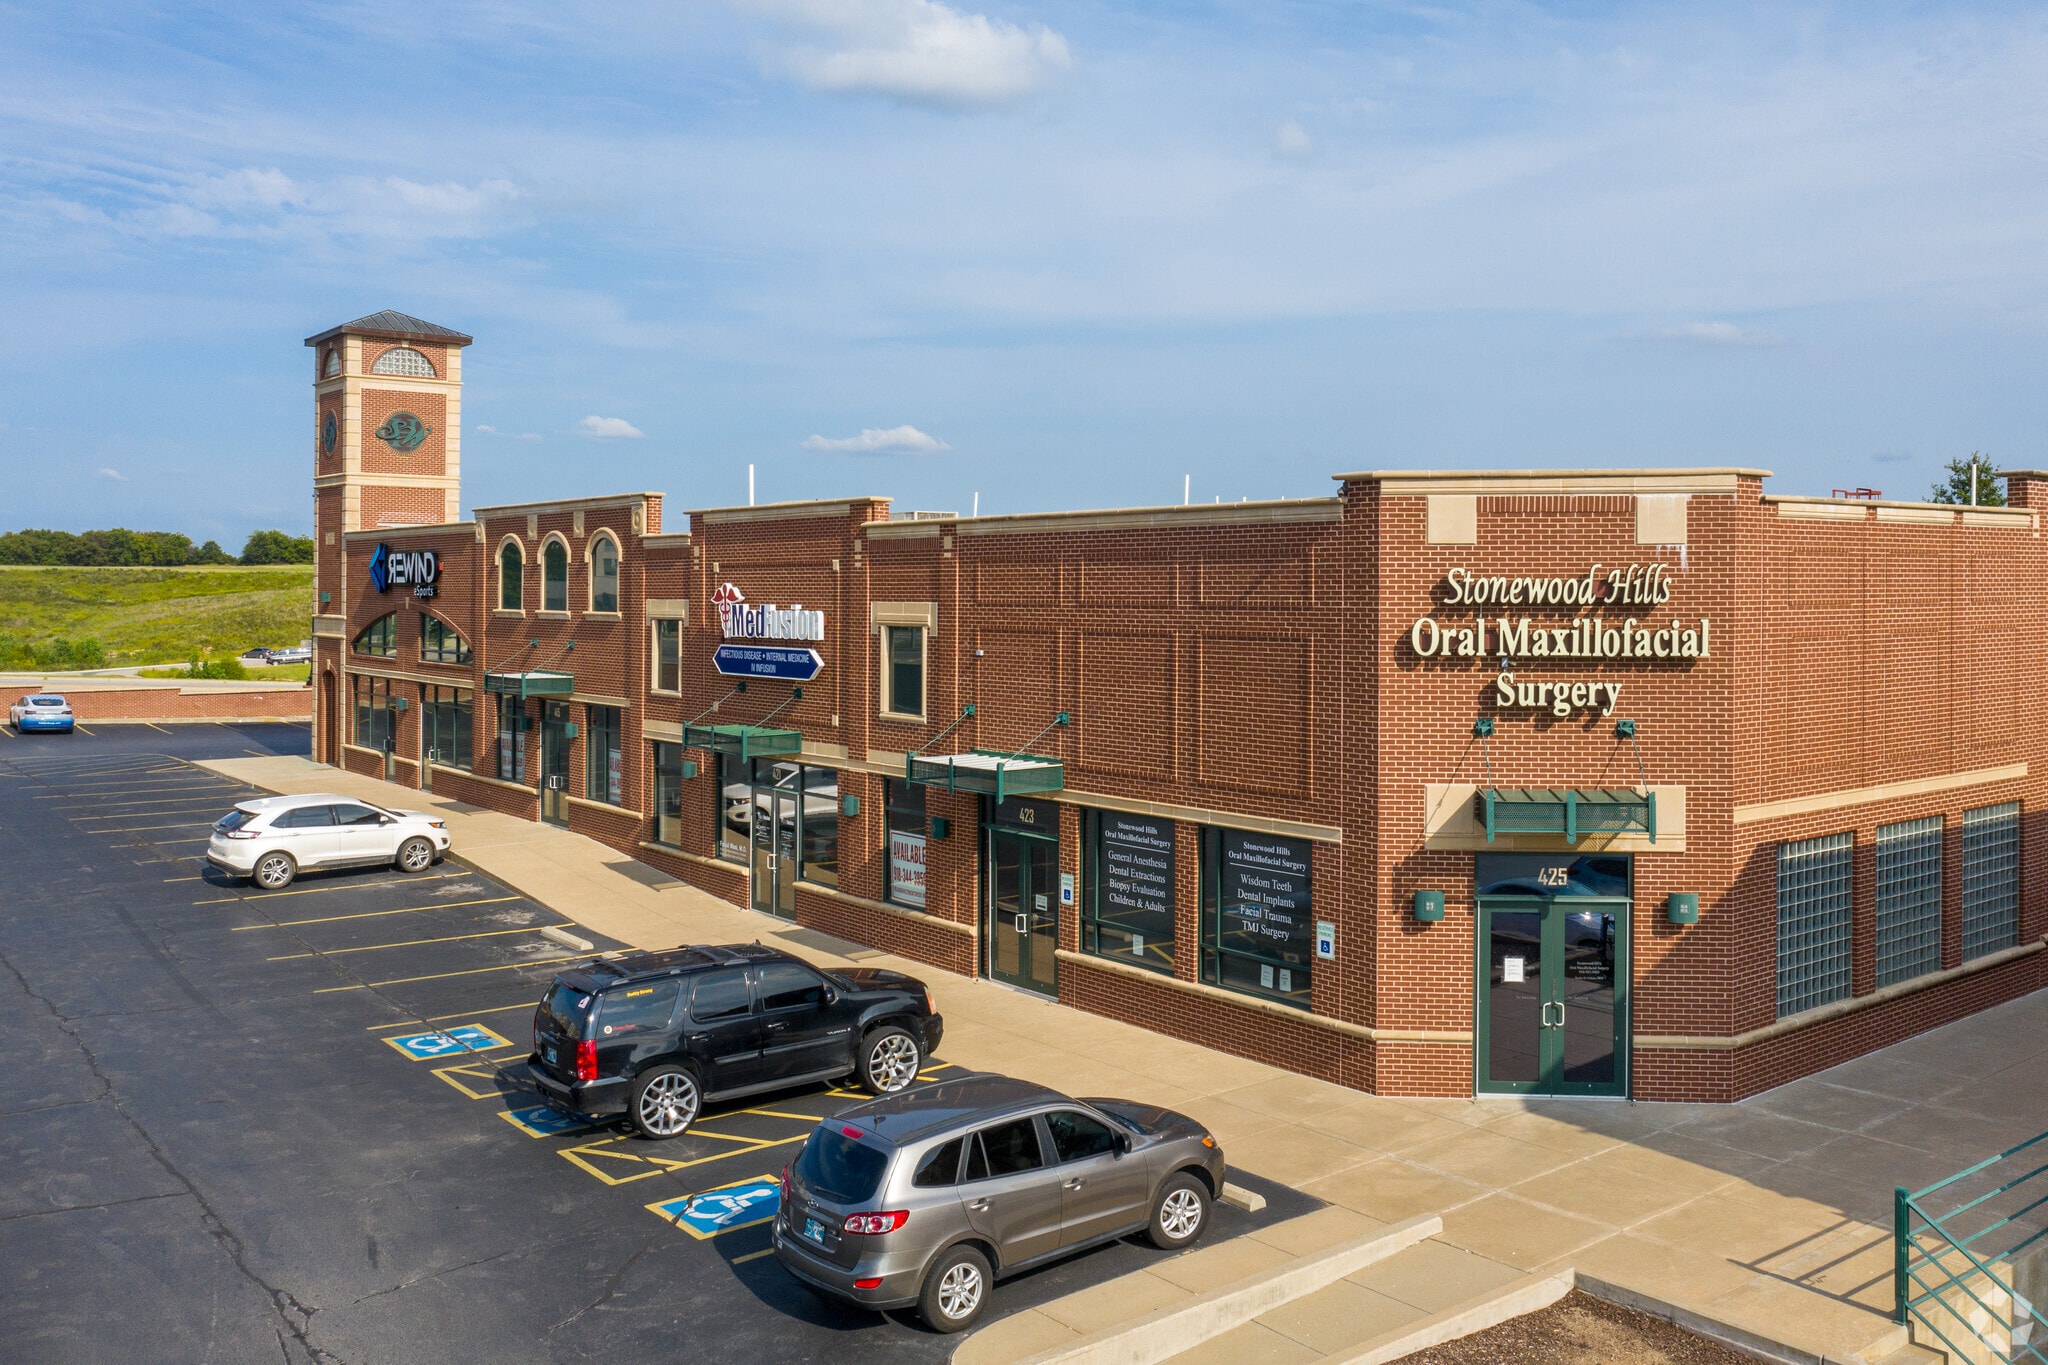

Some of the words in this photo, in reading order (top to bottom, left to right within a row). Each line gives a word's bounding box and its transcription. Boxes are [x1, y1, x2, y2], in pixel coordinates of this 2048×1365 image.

[388, 552, 435, 584] REWIND
[414, 586, 434, 598] eSports
[1443, 563, 1603, 607] Stonewood
[1603, 563, 1673, 606] Hills
[731, 604, 820, 640] MedFusion
[1411, 617, 1488, 657] Oral
[1496, 617, 1711, 658] Maxillofacial
[744, 650, 762, 661] DISEASE
[766, 652, 788, 663] INTERNAL
[756, 664, 776, 674] INFUSION
[1496, 672, 1623, 717] Surgery
[1019, 807, 1035, 824] 423
[1117, 821, 1145, 834] Stonewood
[1145, 824, 1158, 835] Hills
[1104, 830, 1117, 839] Oral
[1117, 831, 1150, 845] Maxillofacial
[1150, 836, 1171, 849] Surgery
[1243, 841, 1275, 854] Stonewood
[1276, 845, 1291, 856] Hills
[1108, 850, 1132, 864] General
[1132, 854, 1167, 869] Anesthesia
[1228, 850, 1242, 860] Oral
[1242, 852, 1281, 867] Maxillofacial
[1282, 859, 1307, 872] Surgery
[1109, 864, 1130, 877] Dental
[1130, 868, 1166, 884] Extractions
[1240, 873, 1270, 888] Wisdom
[1271, 879, 1293, 893] Teeth
[1537, 867, 1568, 886] 425
[1109, 878, 1131, 892] Biopsy
[1132, 882, 1166, 899] Evaluation
[1237, 888, 1261, 902] Dental
[1263, 893, 1295, 909] Implants
[1109, 892, 1136, 907] Children
[1136, 898, 1143, 909] &
[1144, 899, 1166, 913] Adults
[1240, 904, 1262, 918] Facial
[1263, 909, 1292, 924] Trauma
[1242, 920, 1259, 933] TMJ
[1260, 924, 1290, 941] Surgery
